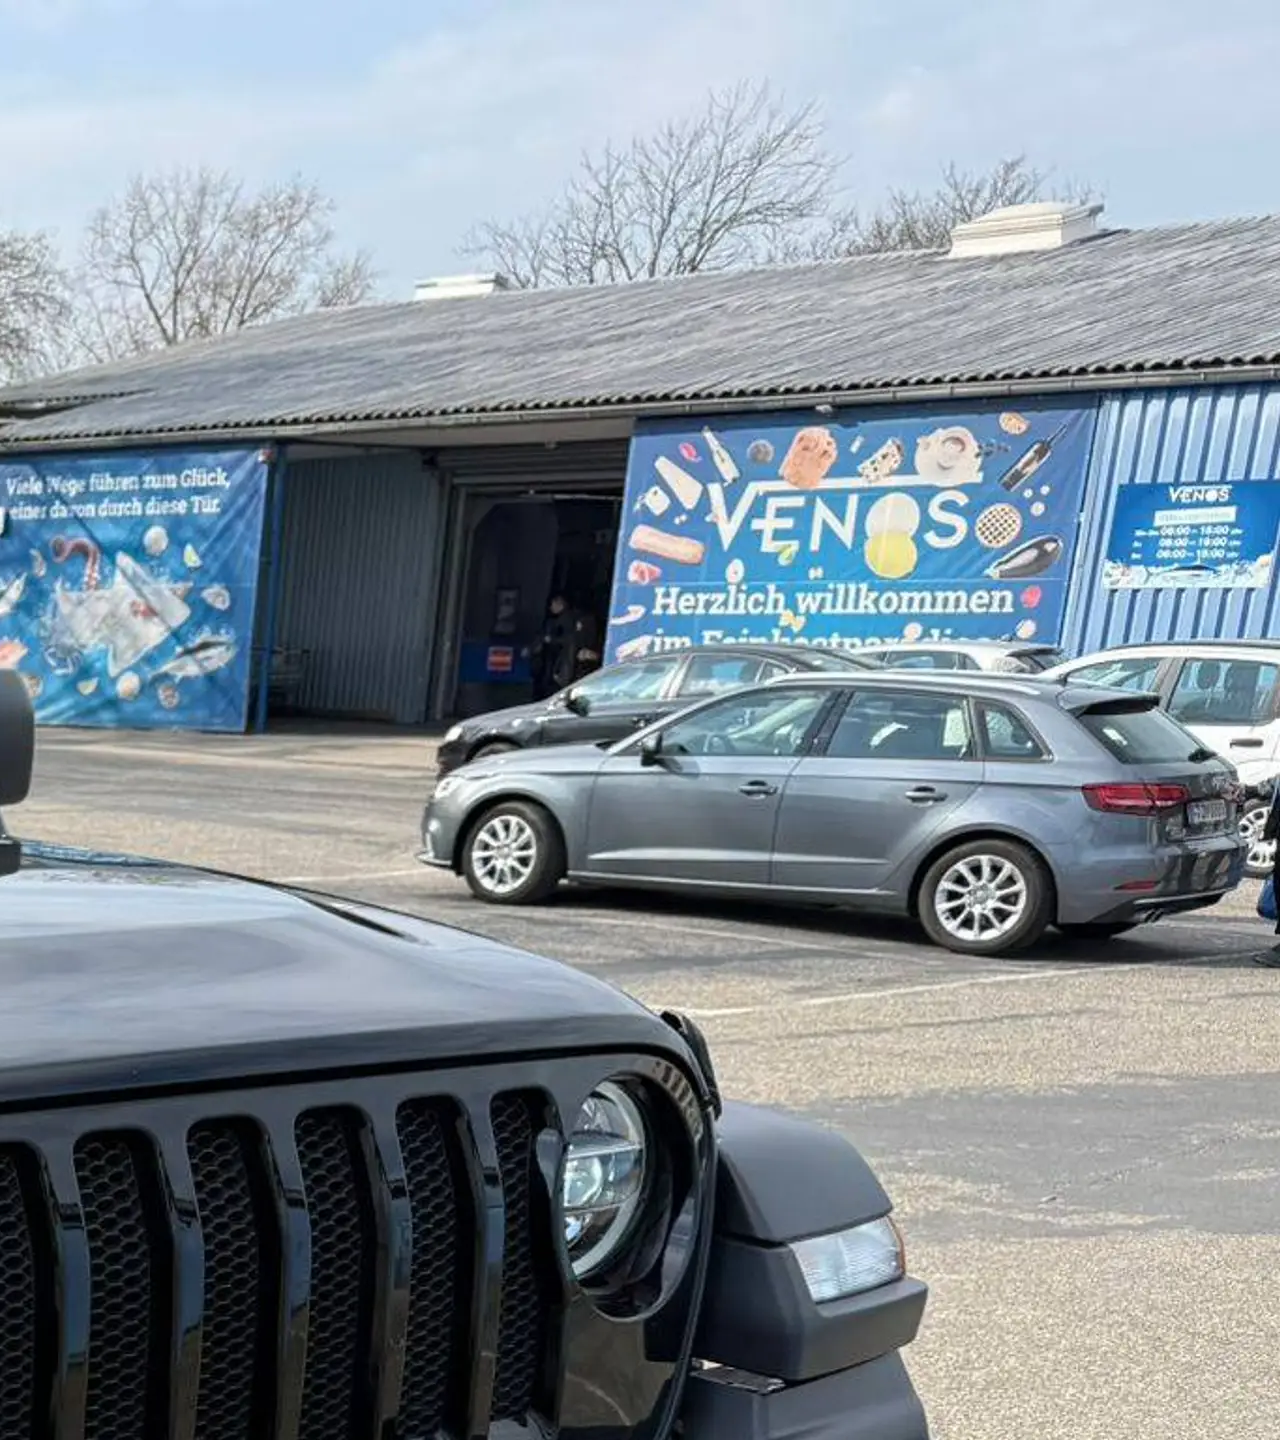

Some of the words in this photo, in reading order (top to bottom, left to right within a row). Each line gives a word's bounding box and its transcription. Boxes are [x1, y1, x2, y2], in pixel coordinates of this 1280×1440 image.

[6, 476, 44, 496] Viele
[89, 472, 139, 492] führen
[142, 474, 177, 489] zum
[180, 467, 231, 490] Glück,
[1169, 485, 1230, 503] VENOS
[9, 501, 47, 519] einer
[49, 500, 96, 518] davon
[98, 497, 142, 517] durch
[145, 496, 188, 515] diese
[190, 495, 221, 514] Tür.
[652, 584, 785, 615] Herzlich
[796, 583, 1014, 614] willkommen
[654, 627, 691, 652] im
